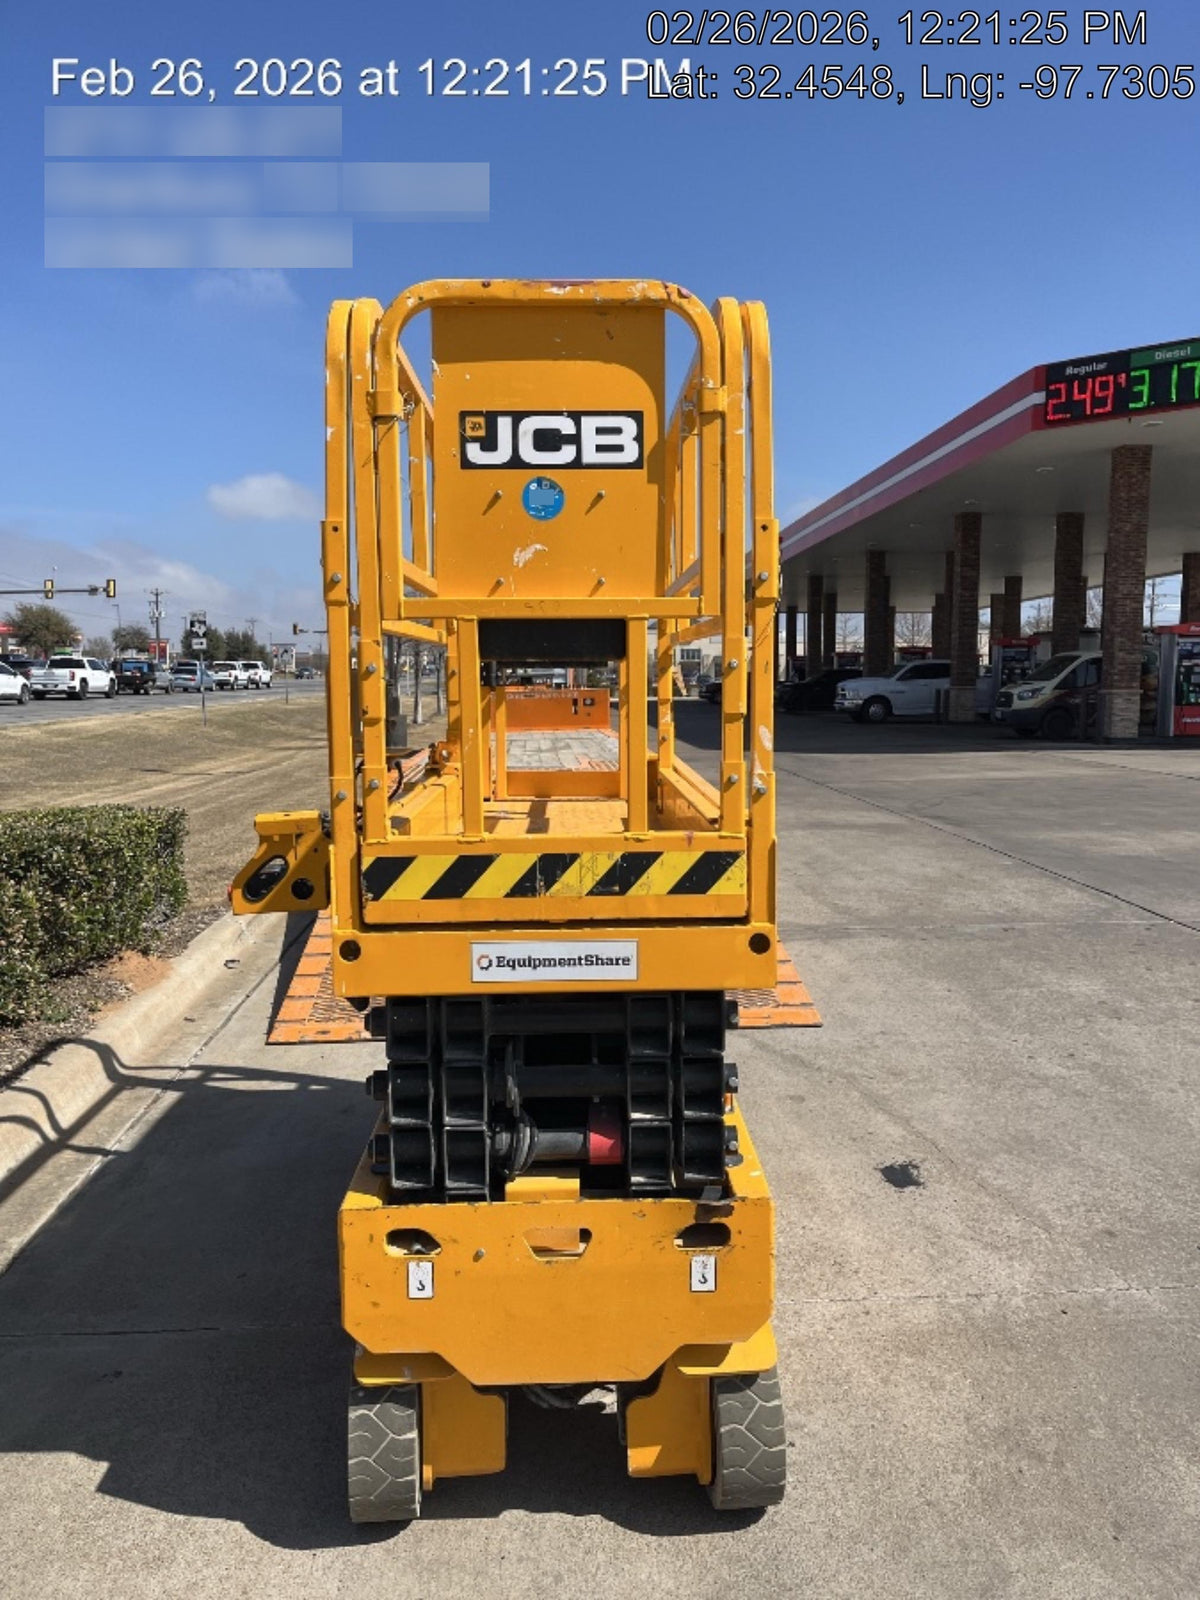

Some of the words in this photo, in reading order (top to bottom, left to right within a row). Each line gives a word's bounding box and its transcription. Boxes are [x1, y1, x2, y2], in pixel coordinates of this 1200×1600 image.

[1154, 346, 1192, 360] Diesel
[1064, 361, 1109, 376] Regular
[465, 415, 639, 465] JCB
[495, 954, 631, 970] EquipmentShare
